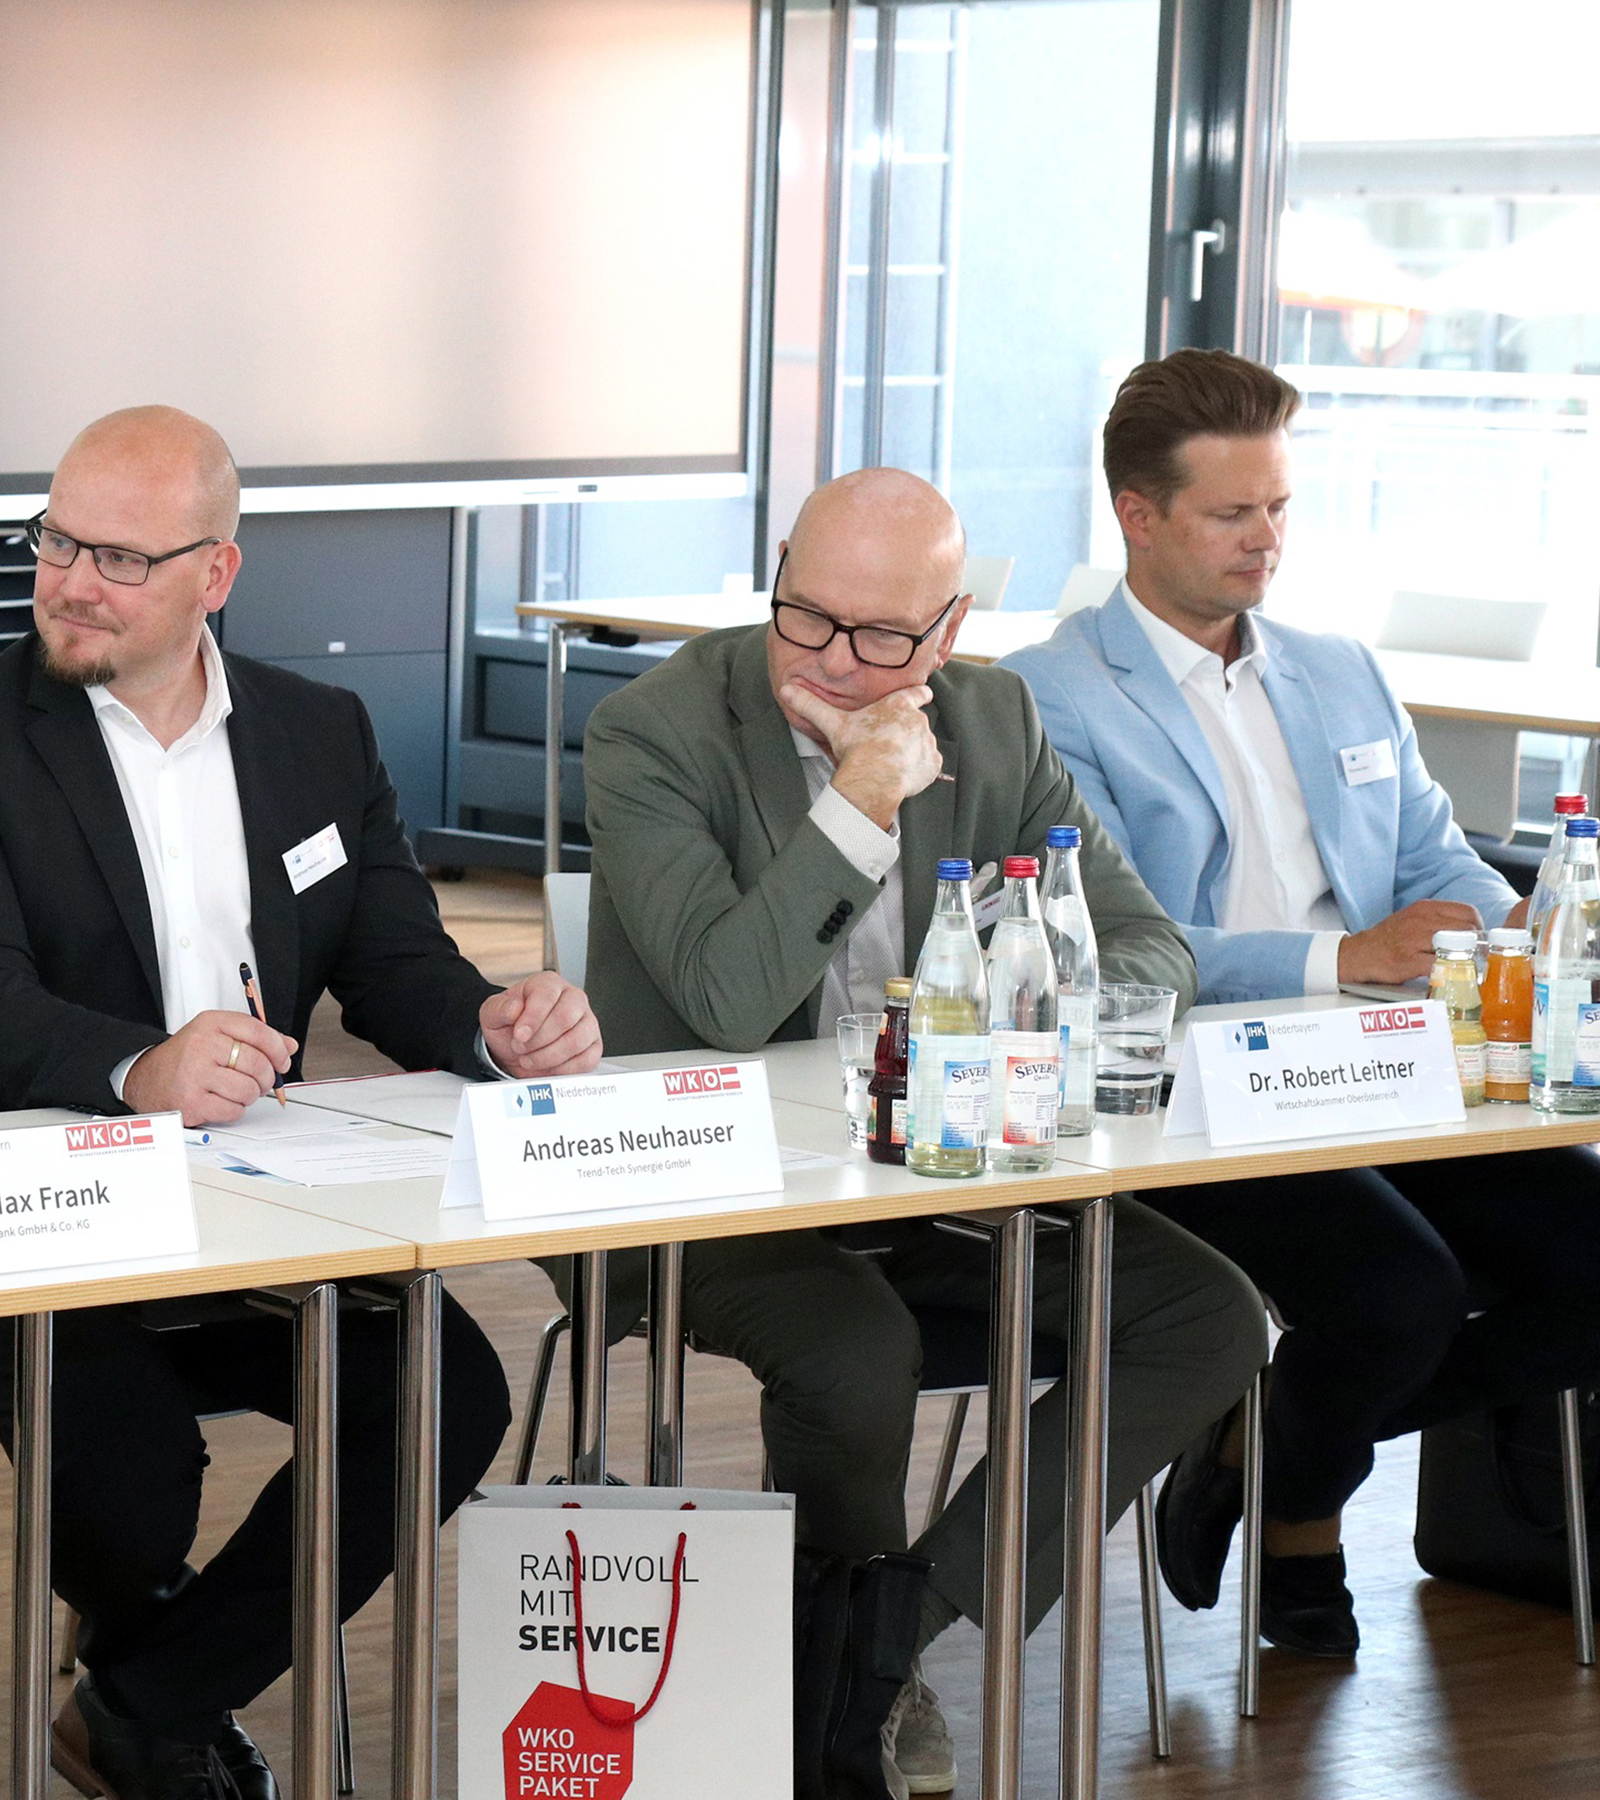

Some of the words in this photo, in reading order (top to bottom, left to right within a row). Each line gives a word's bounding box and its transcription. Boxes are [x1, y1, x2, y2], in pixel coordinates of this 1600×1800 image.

[1246, 1025, 1265, 1037] IHK
[1268, 1022, 1320, 1035] Niederbayern
[1360, 1010, 1406, 1029] WKO
[664, 1071, 718, 1092] WKO
[1249, 1072, 1278, 1093] Dr.
[1282, 1064, 1347, 1089] Robert
[1350, 1059, 1414, 1082] Leitner
[531, 1087, 552, 1101] IHK
[555, 1085, 617, 1098] Niederbayern
[1275, 1096, 1345, 1110] Wirtschaftskammer
[1346, 1089, 1399, 1103] Oberösterreich
[67, 1124, 128, 1147] WKO
[523, 1135, 614, 1162] Andreas
[619, 1124, 734, 1152] Neuhauser
[577, 1165, 625, 1179] Trend-Tech
[627, 1161, 663, 1178] Synergie
[664, 1158, 691, 1170] GmbH
[39, 1180, 110, 1210] Frank
[18, 1224, 48, 1236] GmbH
[50, 1222, 57, 1233] &
[59, 1221, 75, 1231] Co.
[76, 1218, 90, 1229] KG
[520, 1554, 699, 1582] RANDVOLL
[520, 1589, 575, 1616] MIT
[518, 1625, 660, 1652] SERVICE
[518, 1727, 574, 1749] WKO
[518, 1752, 621, 1775] SERVICE
[519, 1776, 599, 1798] PAKET
